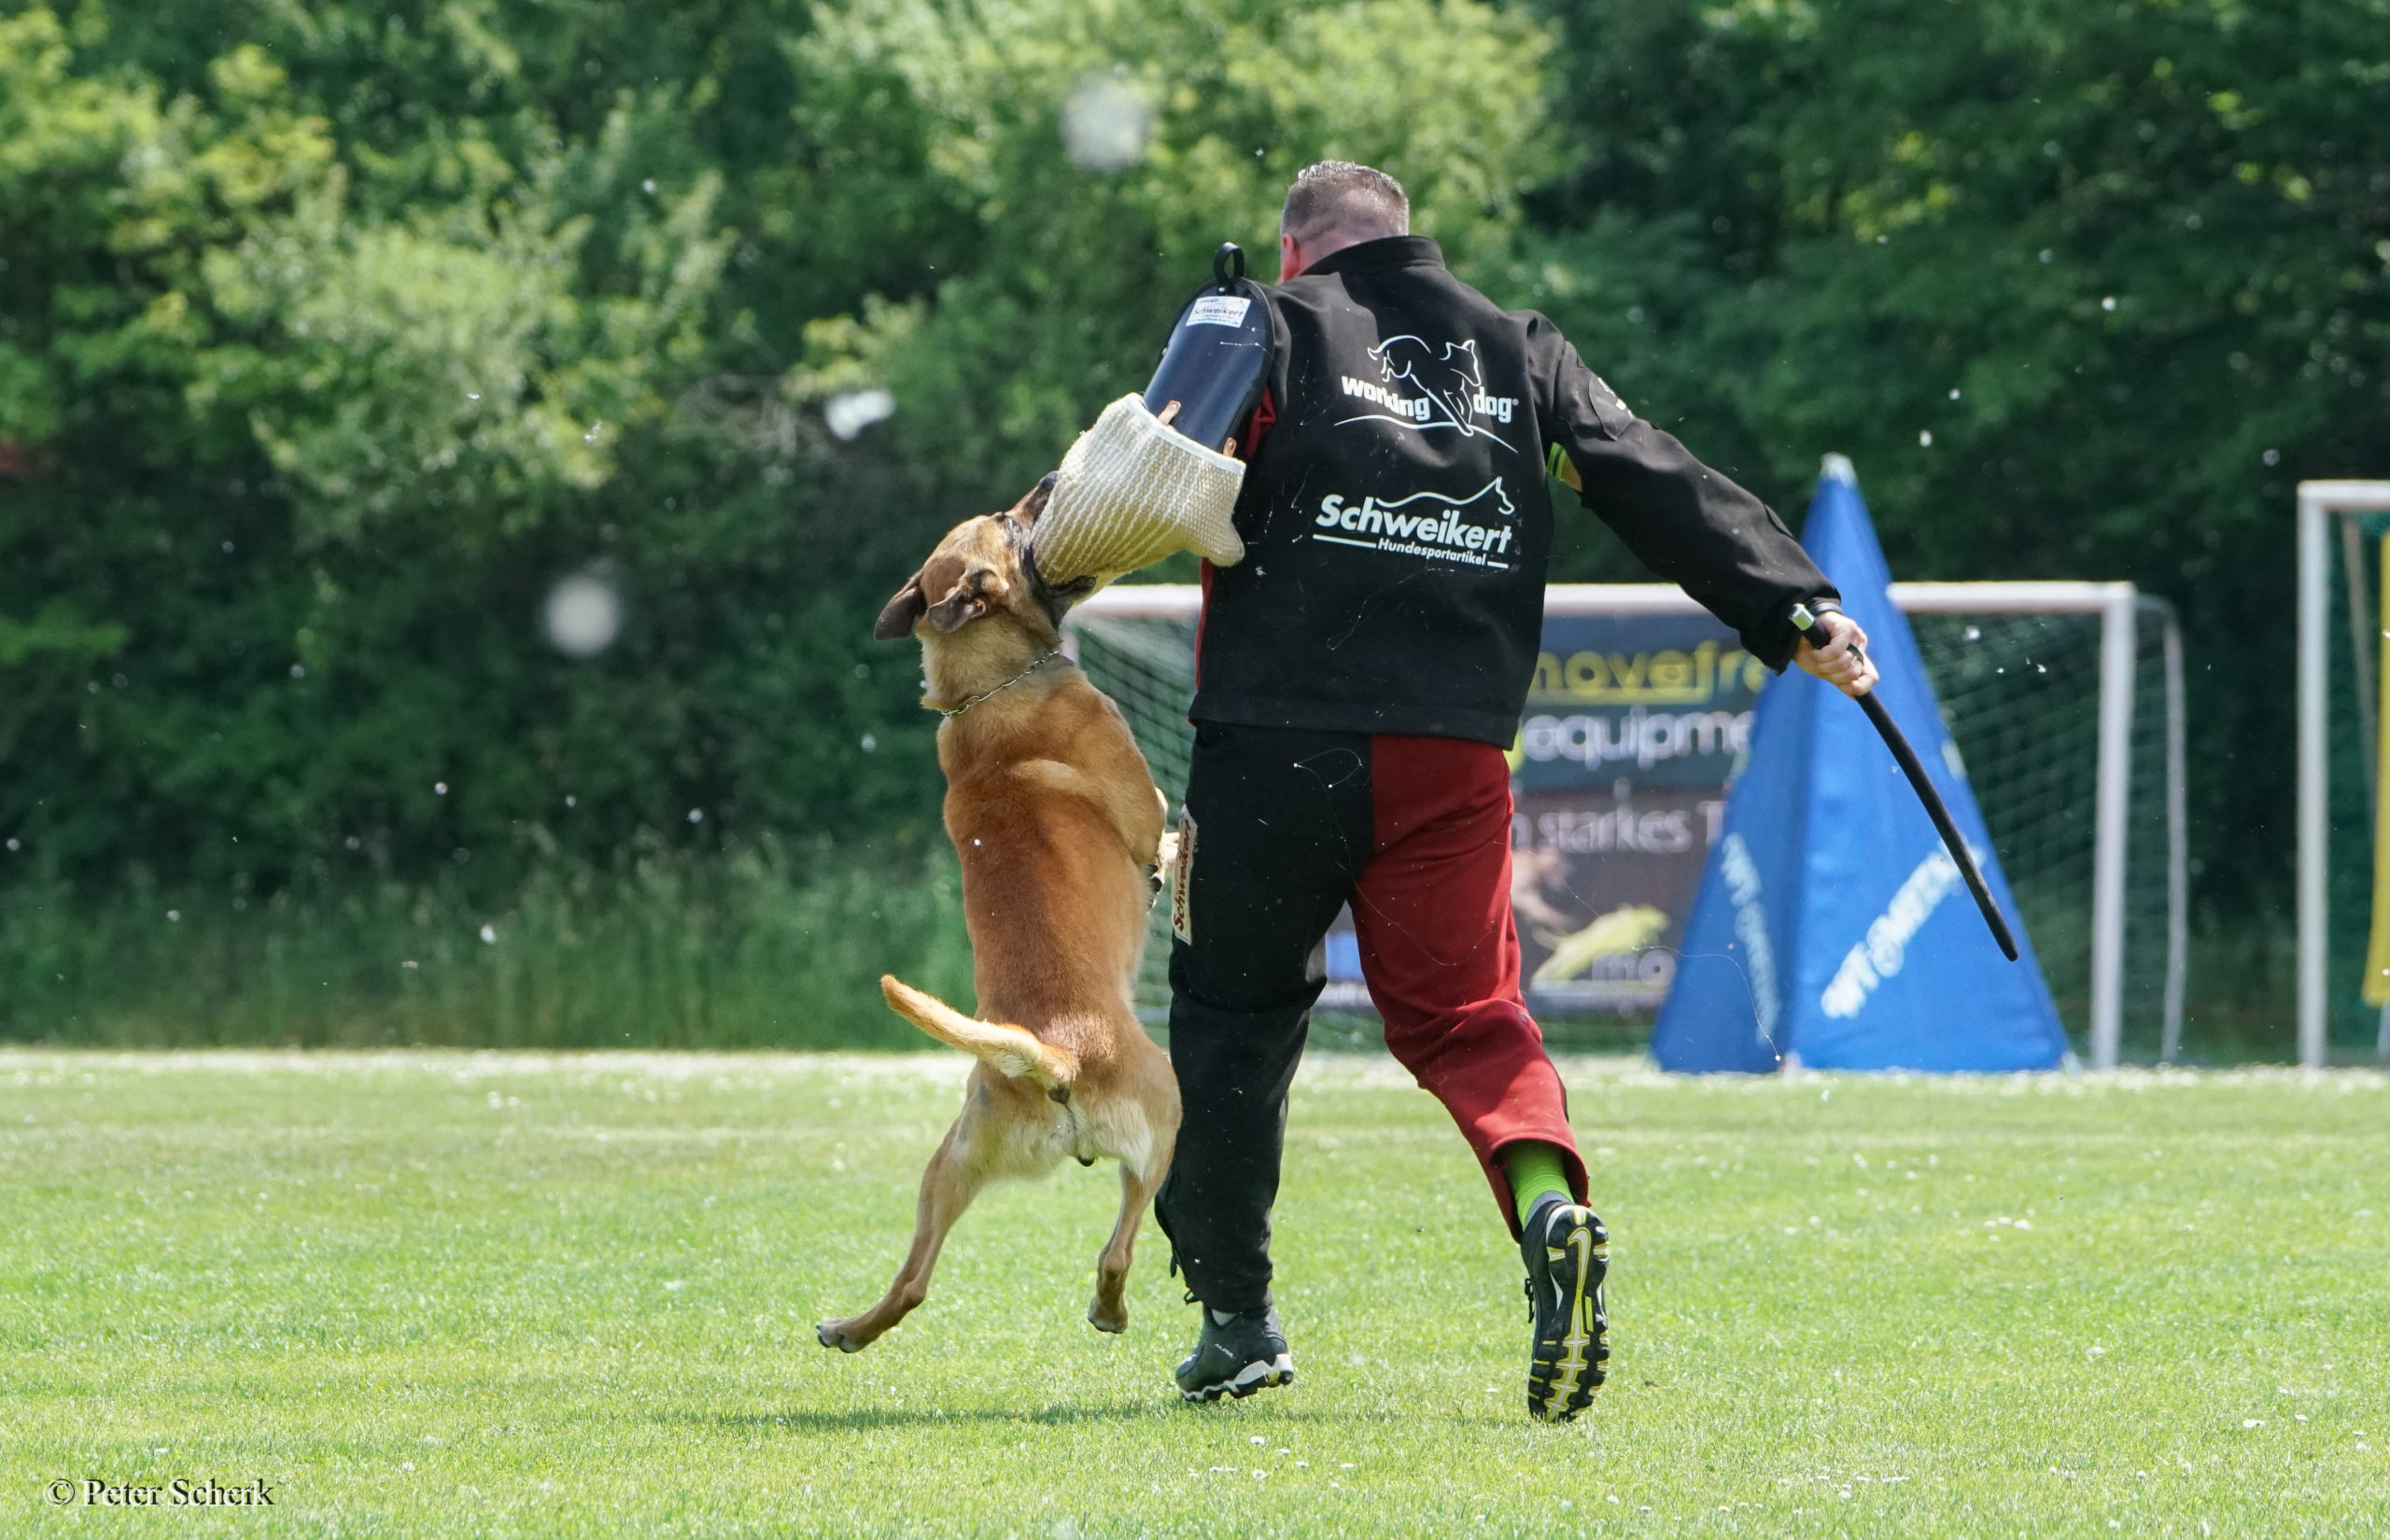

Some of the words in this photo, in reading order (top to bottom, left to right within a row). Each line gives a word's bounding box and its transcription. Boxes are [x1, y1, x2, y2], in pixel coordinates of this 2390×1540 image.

[1342, 375, 1430, 421] working
[1315, 494, 1512, 553] Schweikert
[1377, 538, 1486, 566] Hundesportartikel
[1539, 803, 1693, 853] starkes
